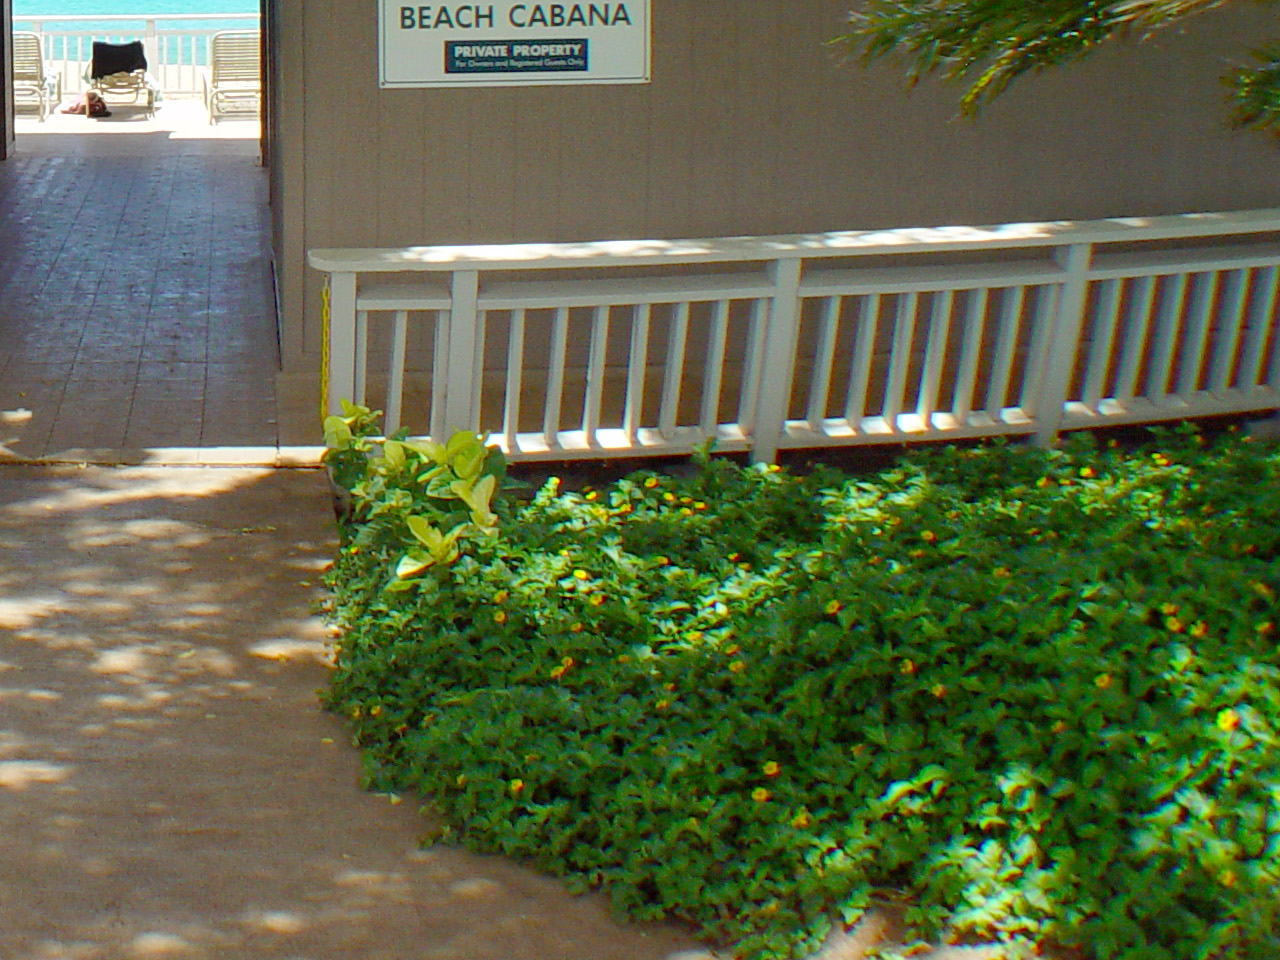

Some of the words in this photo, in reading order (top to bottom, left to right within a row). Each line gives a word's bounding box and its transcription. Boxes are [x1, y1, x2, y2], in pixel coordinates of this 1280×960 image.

[400, 4, 494, 29] BEACH
[508, 3, 632, 27] CABANA
[454, 45, 508, 57] PRIVATE
[513, 44, 582, 56] PROPERTY
[495, 59, 508, 67] and
[567, 58, 584, 67] Only
